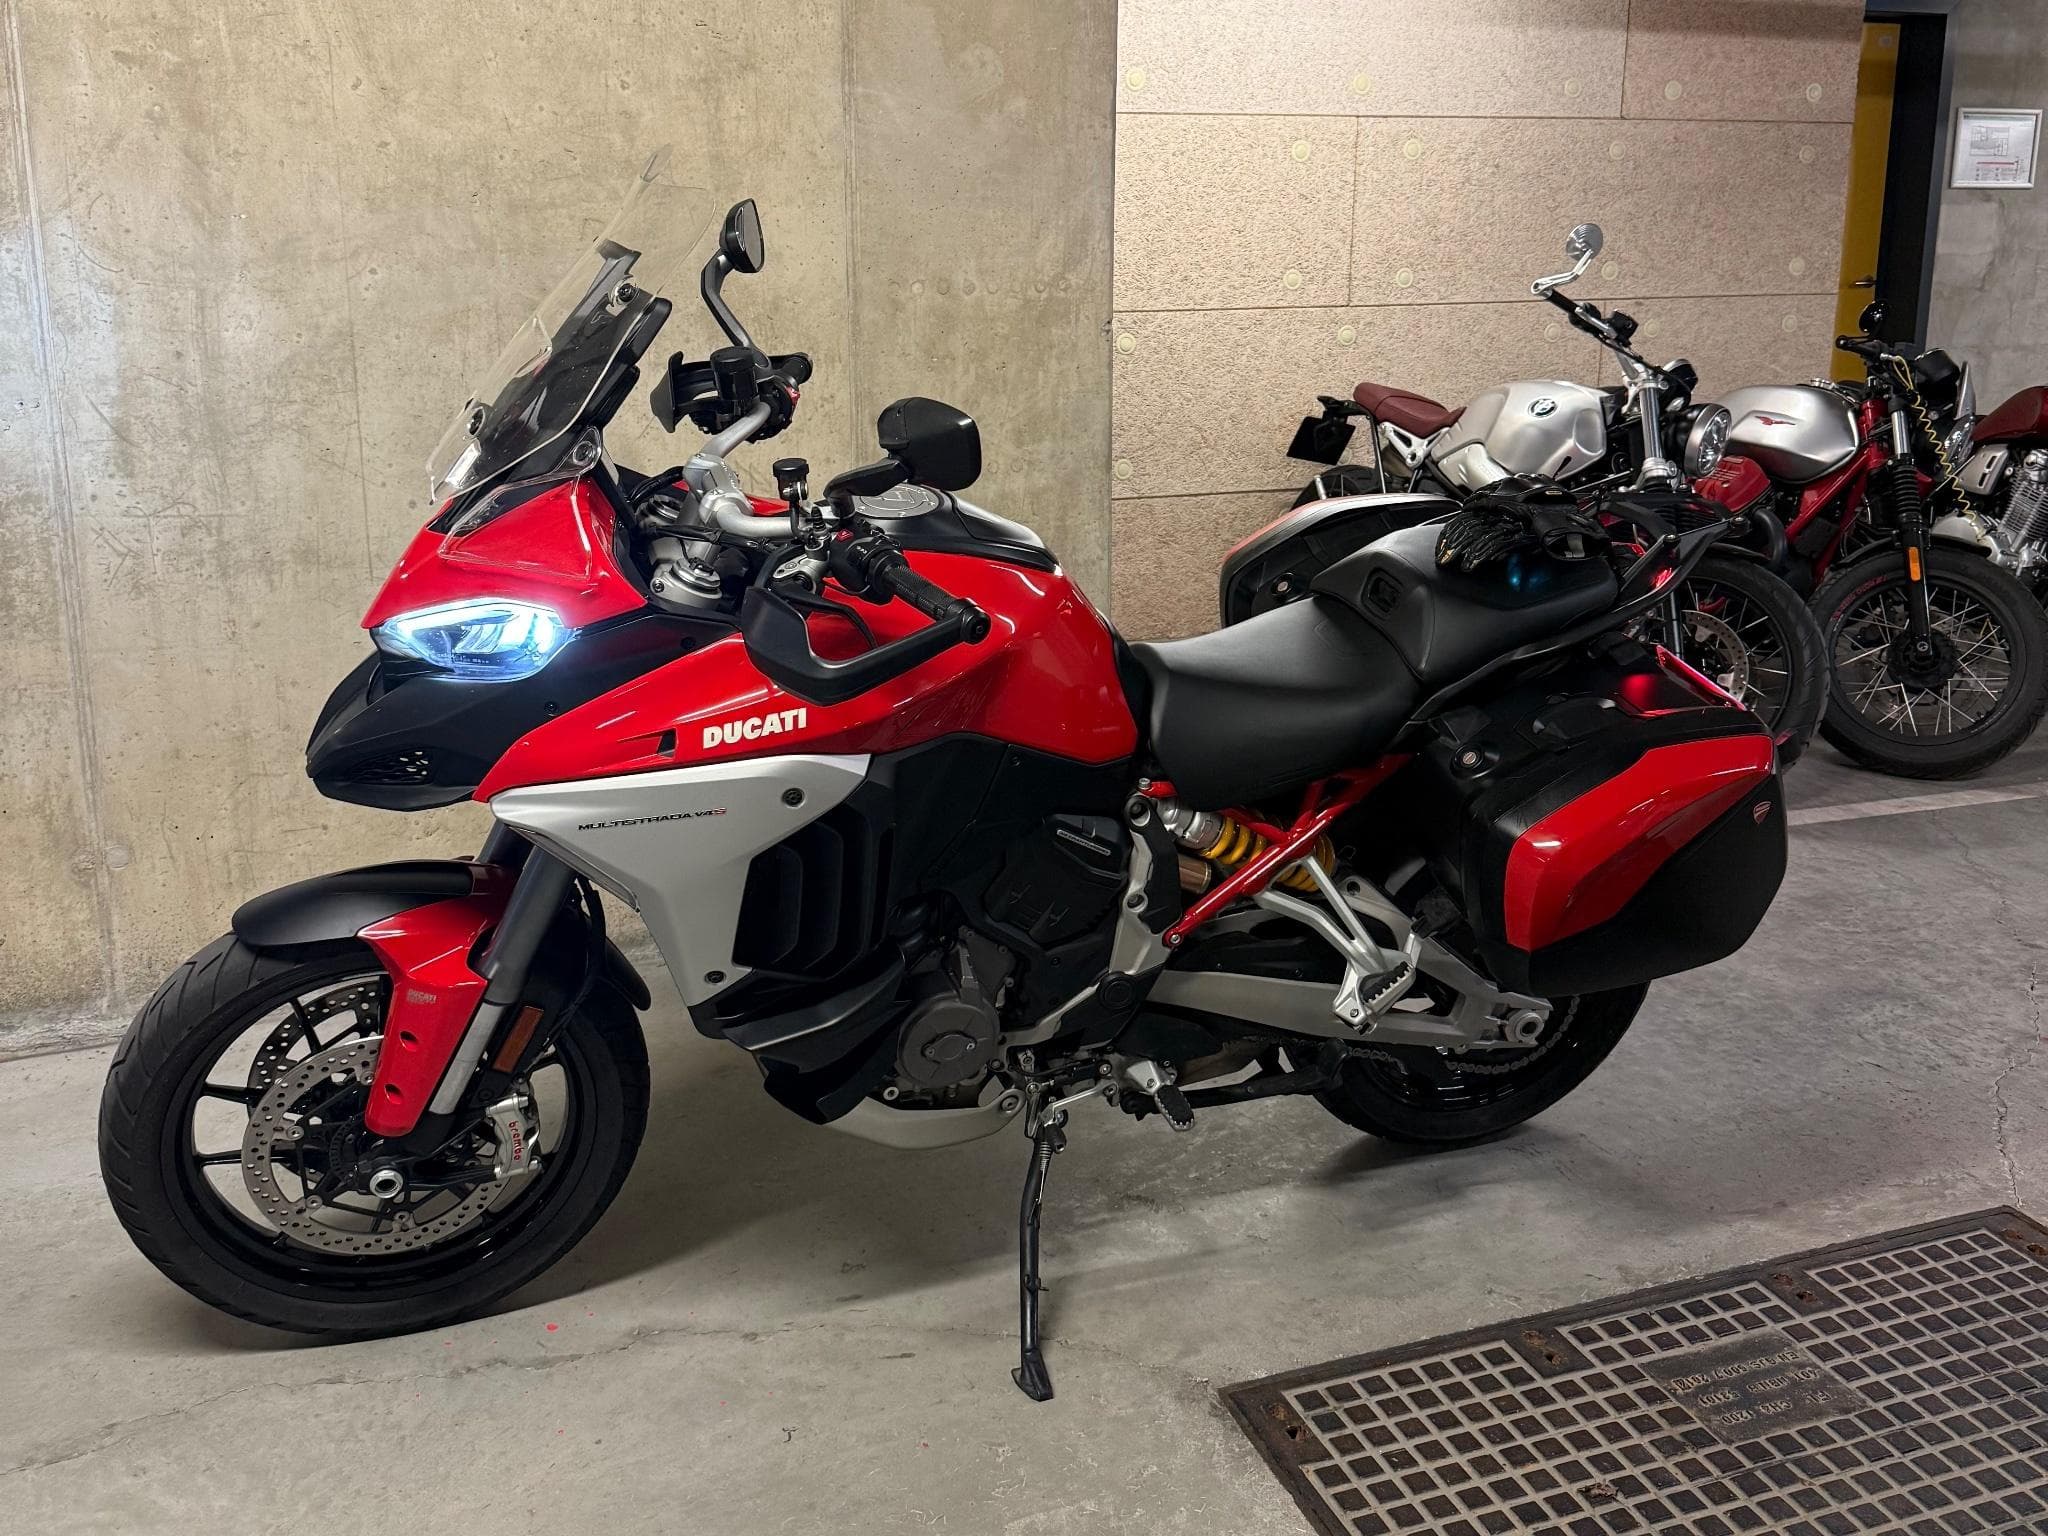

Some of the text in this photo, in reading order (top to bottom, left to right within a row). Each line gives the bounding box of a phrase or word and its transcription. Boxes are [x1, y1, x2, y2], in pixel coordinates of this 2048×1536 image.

[703, 707, 808, 750] DUCATI
[577, 807, 728, 831] MULTISTRADA V4S
[508, 1120, 525, 1161] brembo
